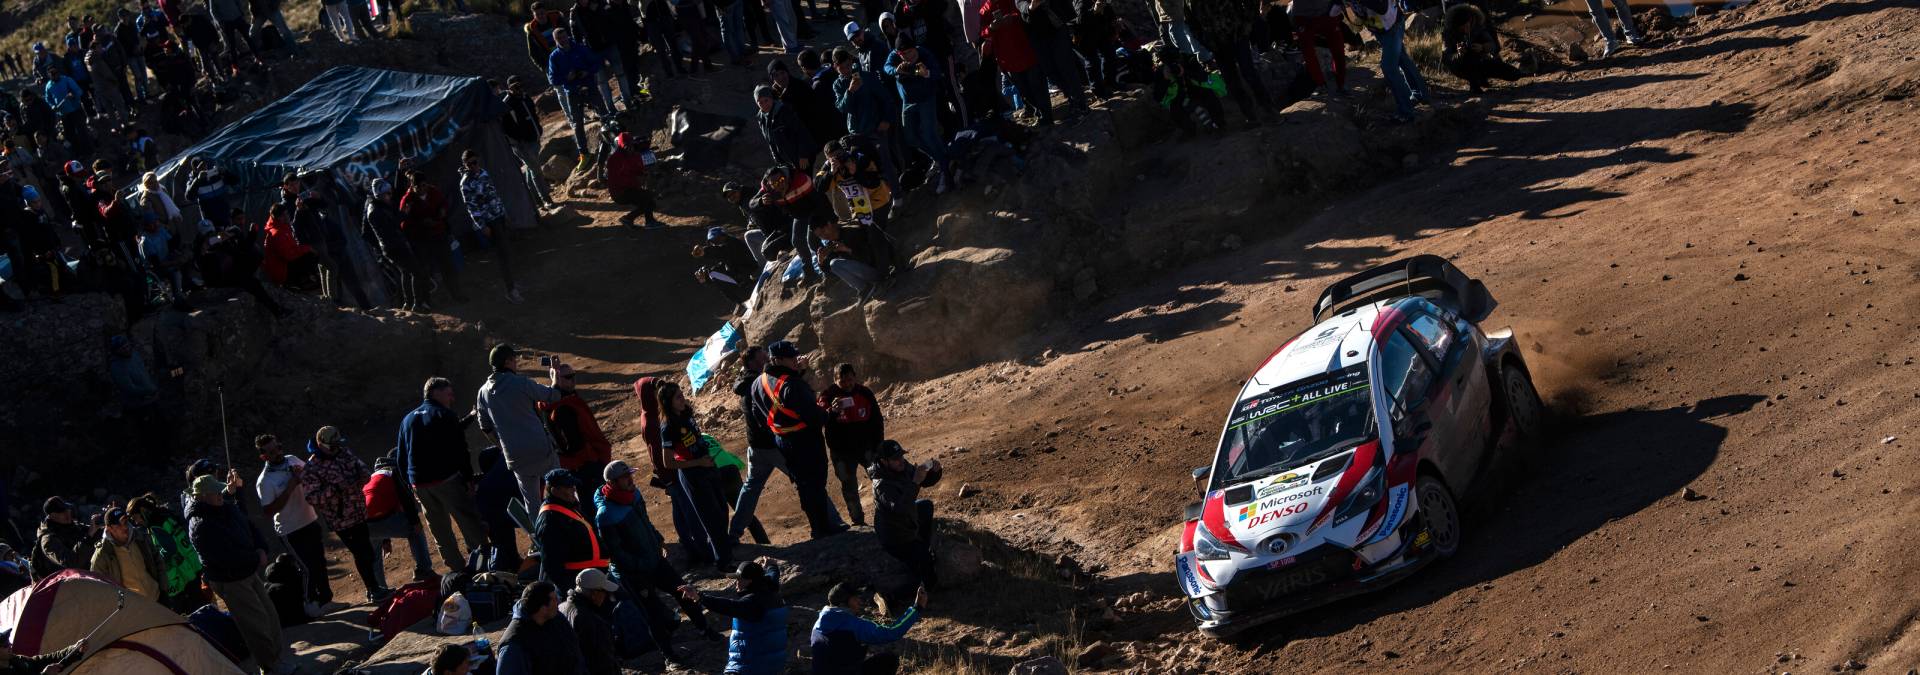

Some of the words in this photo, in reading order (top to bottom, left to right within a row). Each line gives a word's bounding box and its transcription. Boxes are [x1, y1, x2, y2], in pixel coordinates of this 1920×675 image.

[1302, 390, 1323, 402] ALL
[1324, 382, 1348, 395] LIVE
[1260, 486, 1323, 511] Microsoft
[1379, 486, 1407, 537] Panasonic
[1247, 502, 1309, 530] DENSO
[1178, 555, 1202, 594] Panasonic
[1255, 566, 1326, 600] YARIS
